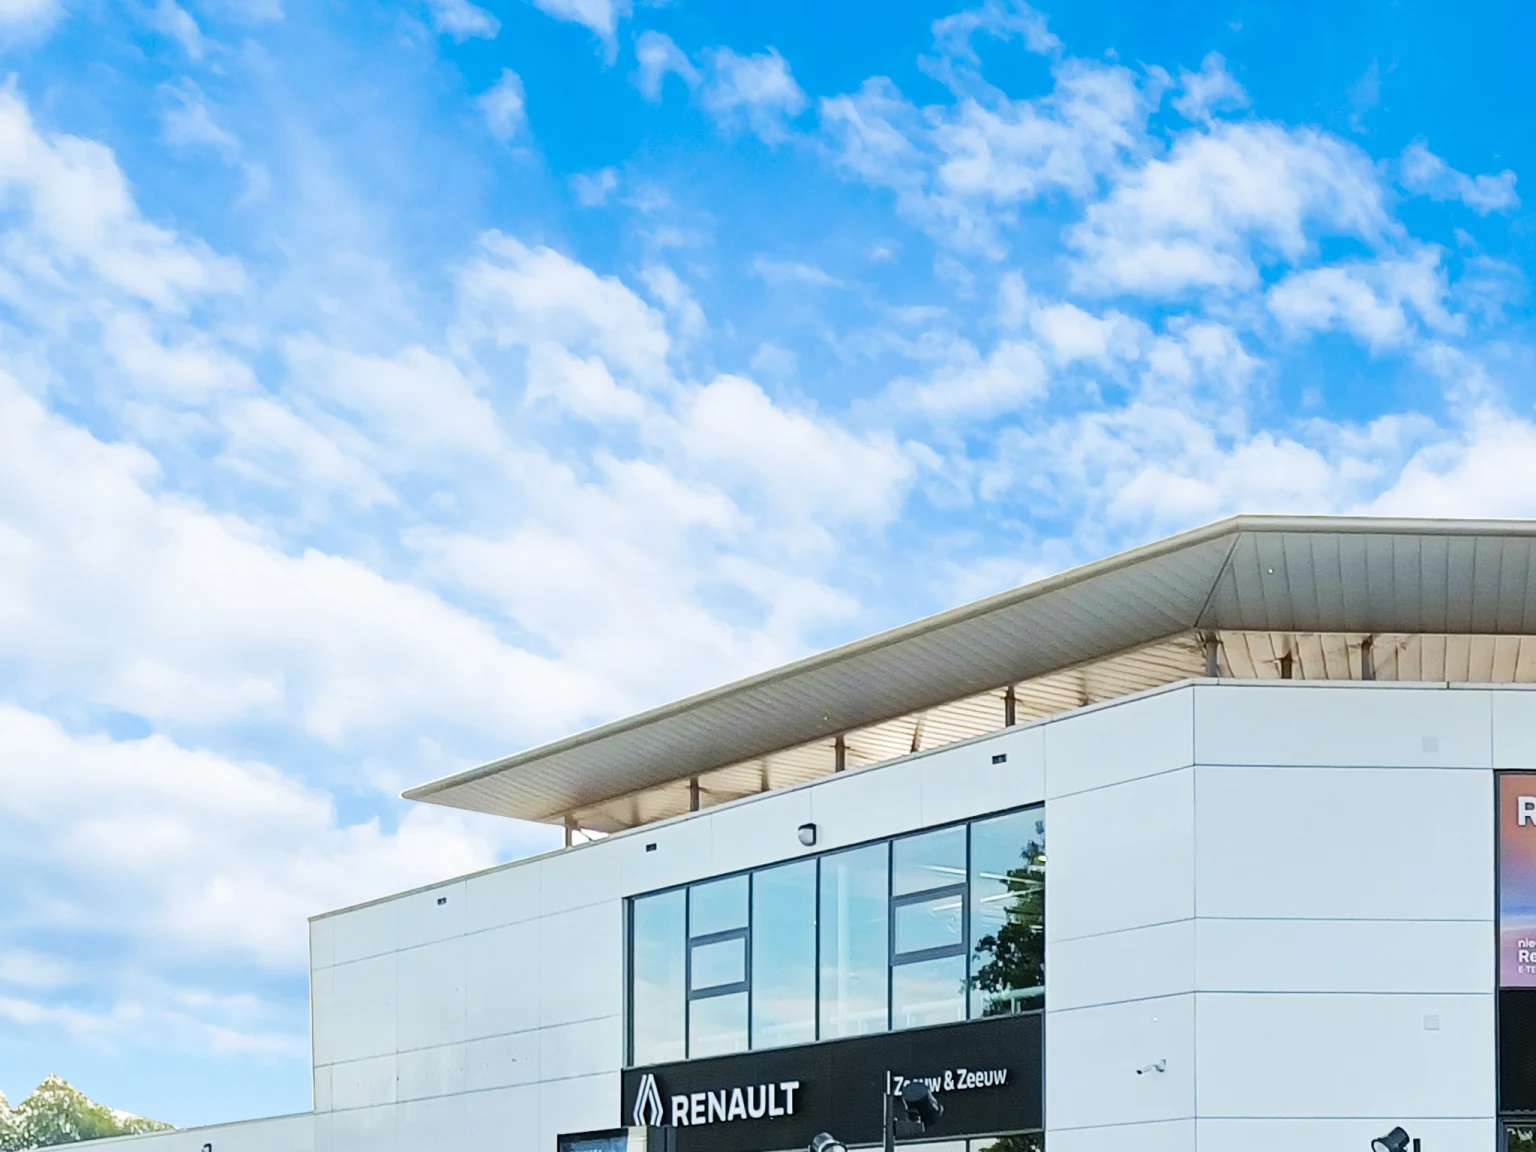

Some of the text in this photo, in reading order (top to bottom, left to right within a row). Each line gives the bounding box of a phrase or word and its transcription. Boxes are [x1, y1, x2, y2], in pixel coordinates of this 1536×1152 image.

[943, 1070, 955, 1091] &
[957, 1068, 1007, 1090] Zeeuw
[671, 1081, 800, 1127] RENAULT
